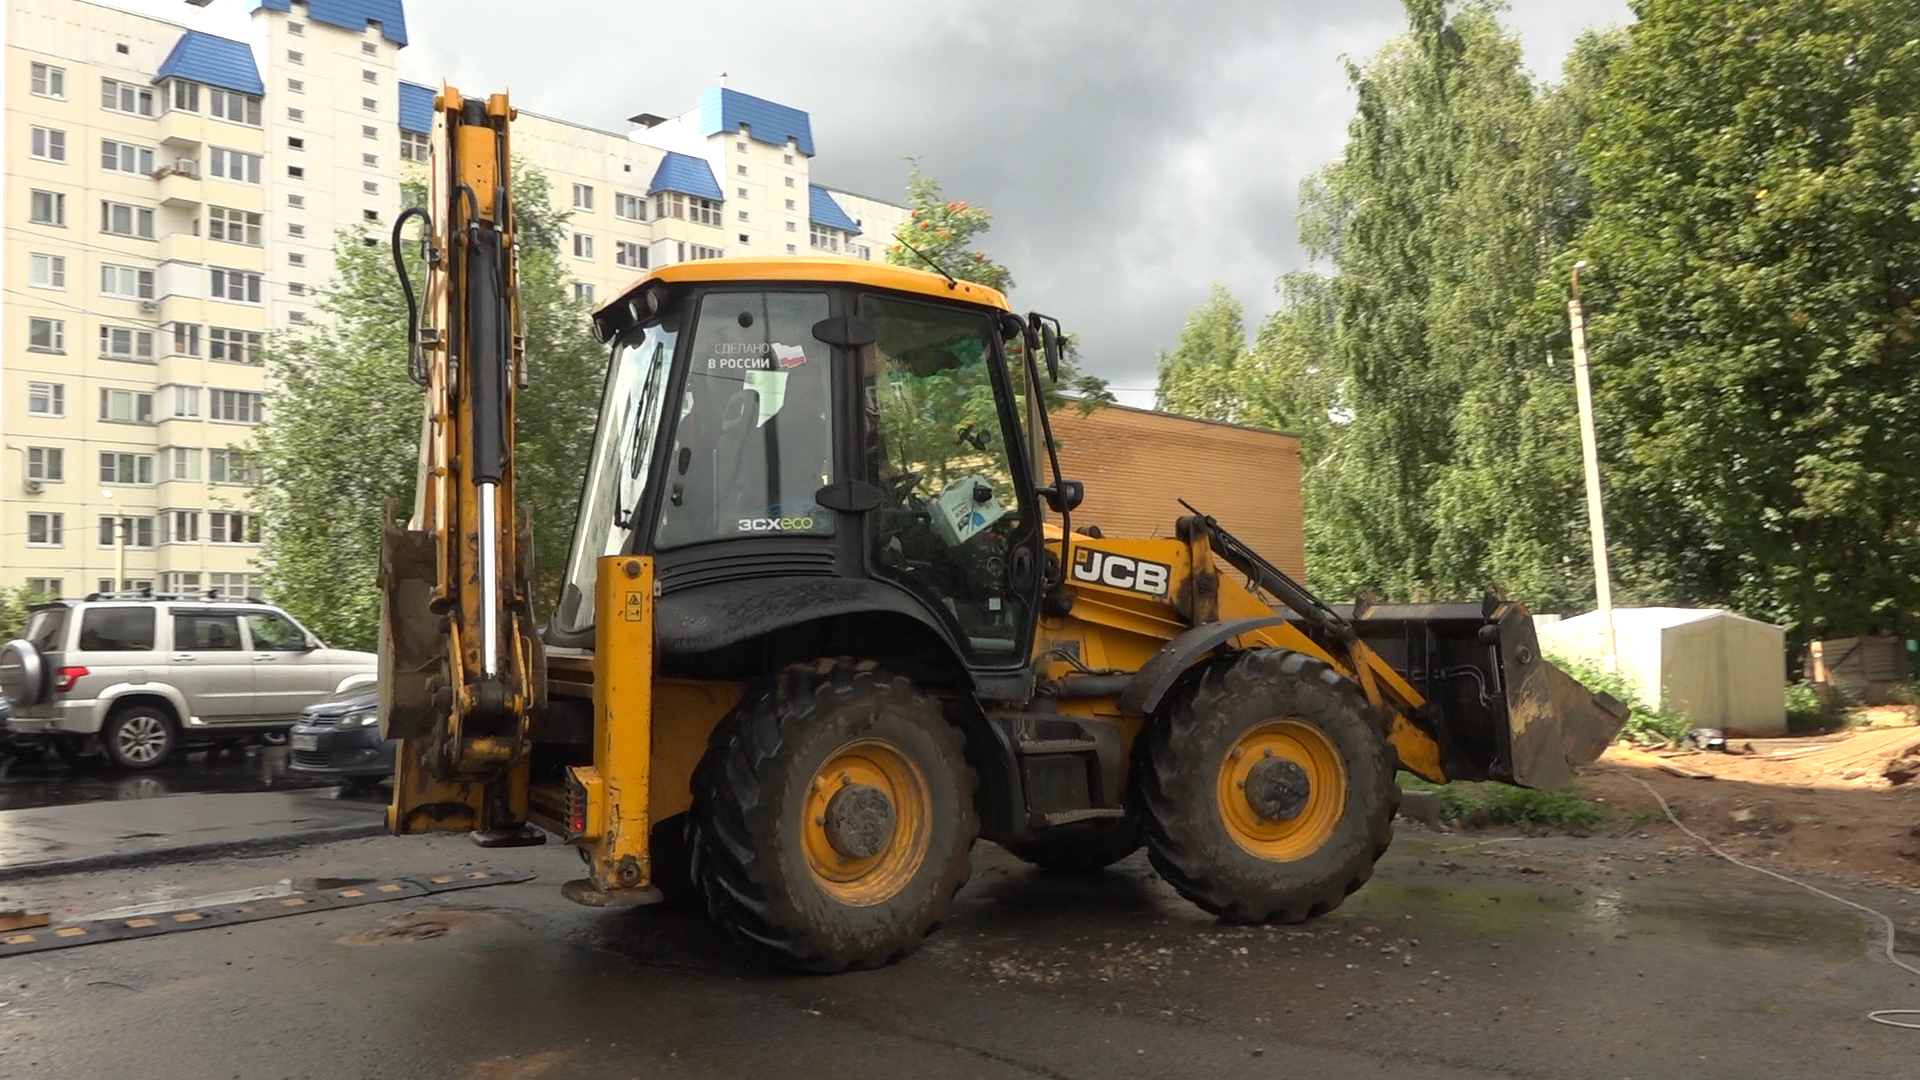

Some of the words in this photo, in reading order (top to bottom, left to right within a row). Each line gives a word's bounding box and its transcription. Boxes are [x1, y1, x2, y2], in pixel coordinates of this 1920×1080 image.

[714, 343, 769, 355] СДЕЛАНО
[707, 358, 716, 369] В
[720, 358, 770, 369] РОССИИ
[1074, 552, 1168, 595] JCB
